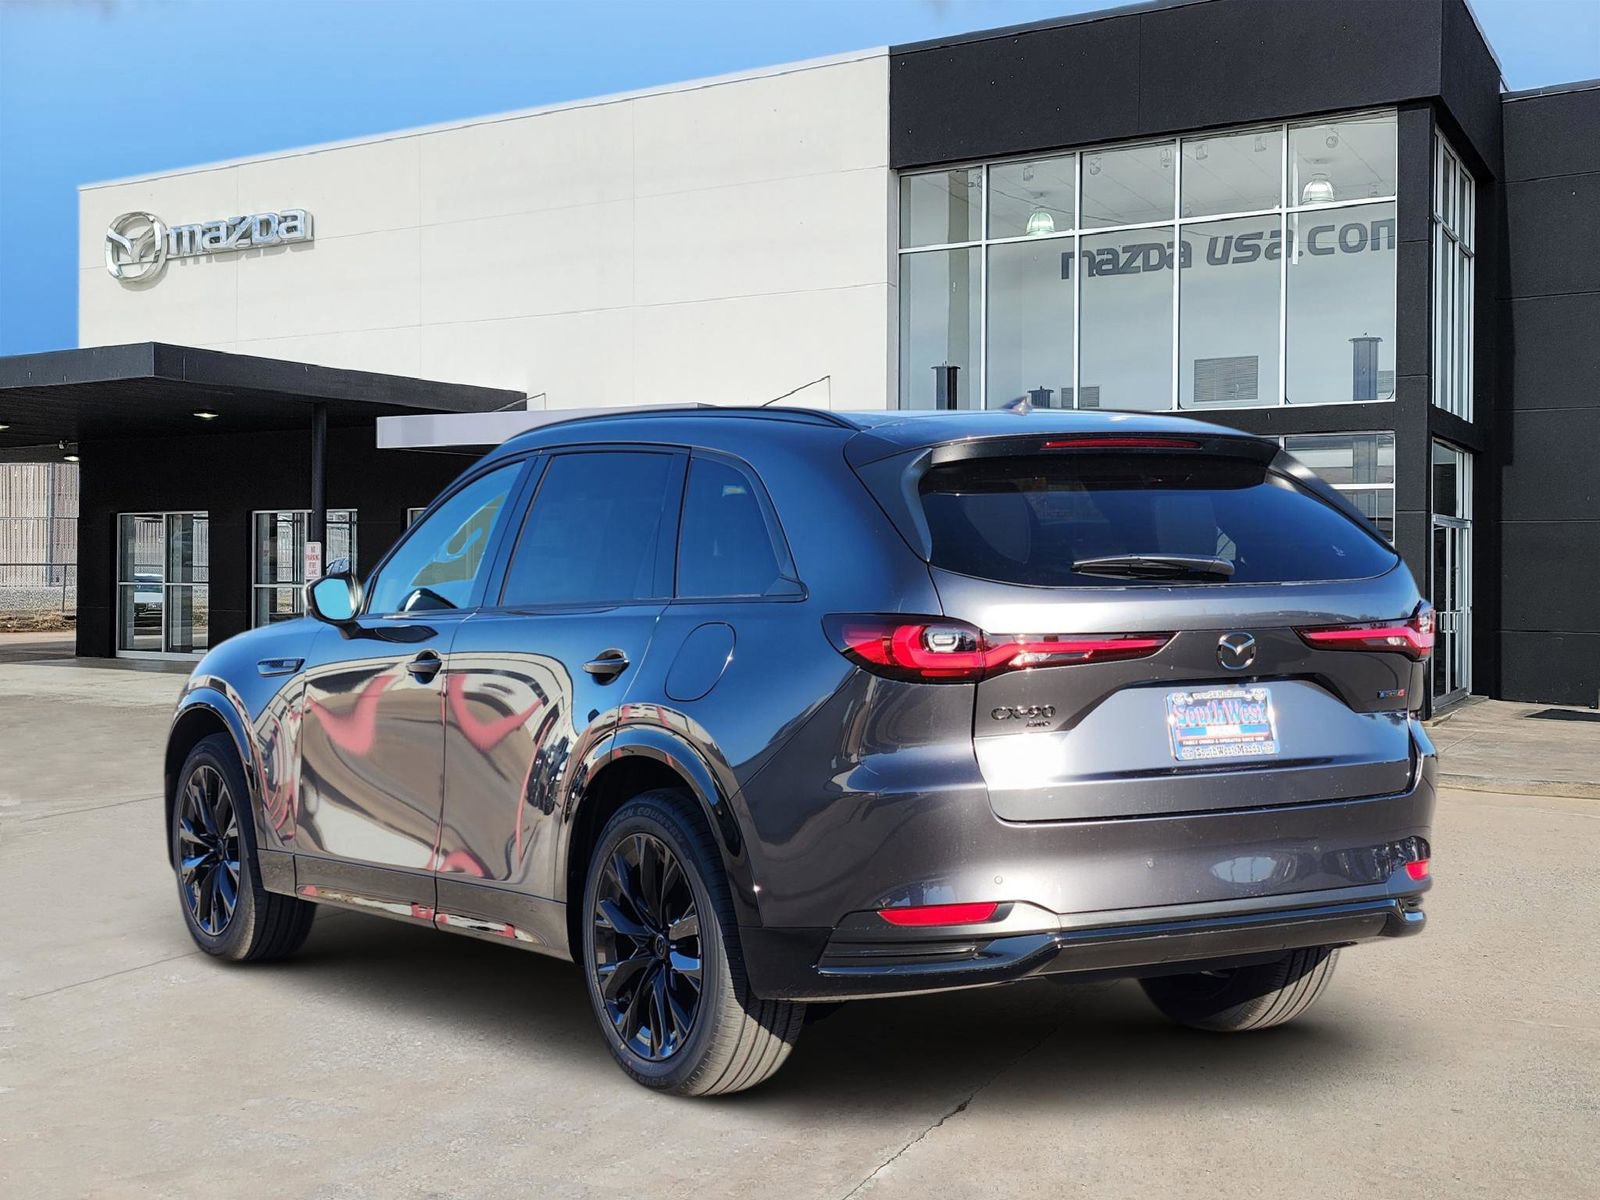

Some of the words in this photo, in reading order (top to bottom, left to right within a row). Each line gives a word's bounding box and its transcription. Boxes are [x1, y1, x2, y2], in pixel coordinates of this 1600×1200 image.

[166, 209, 313, 256] mazda
[1060, 240, 1193, 280] mazda
[991, 704, 1056, 721] CX-90
